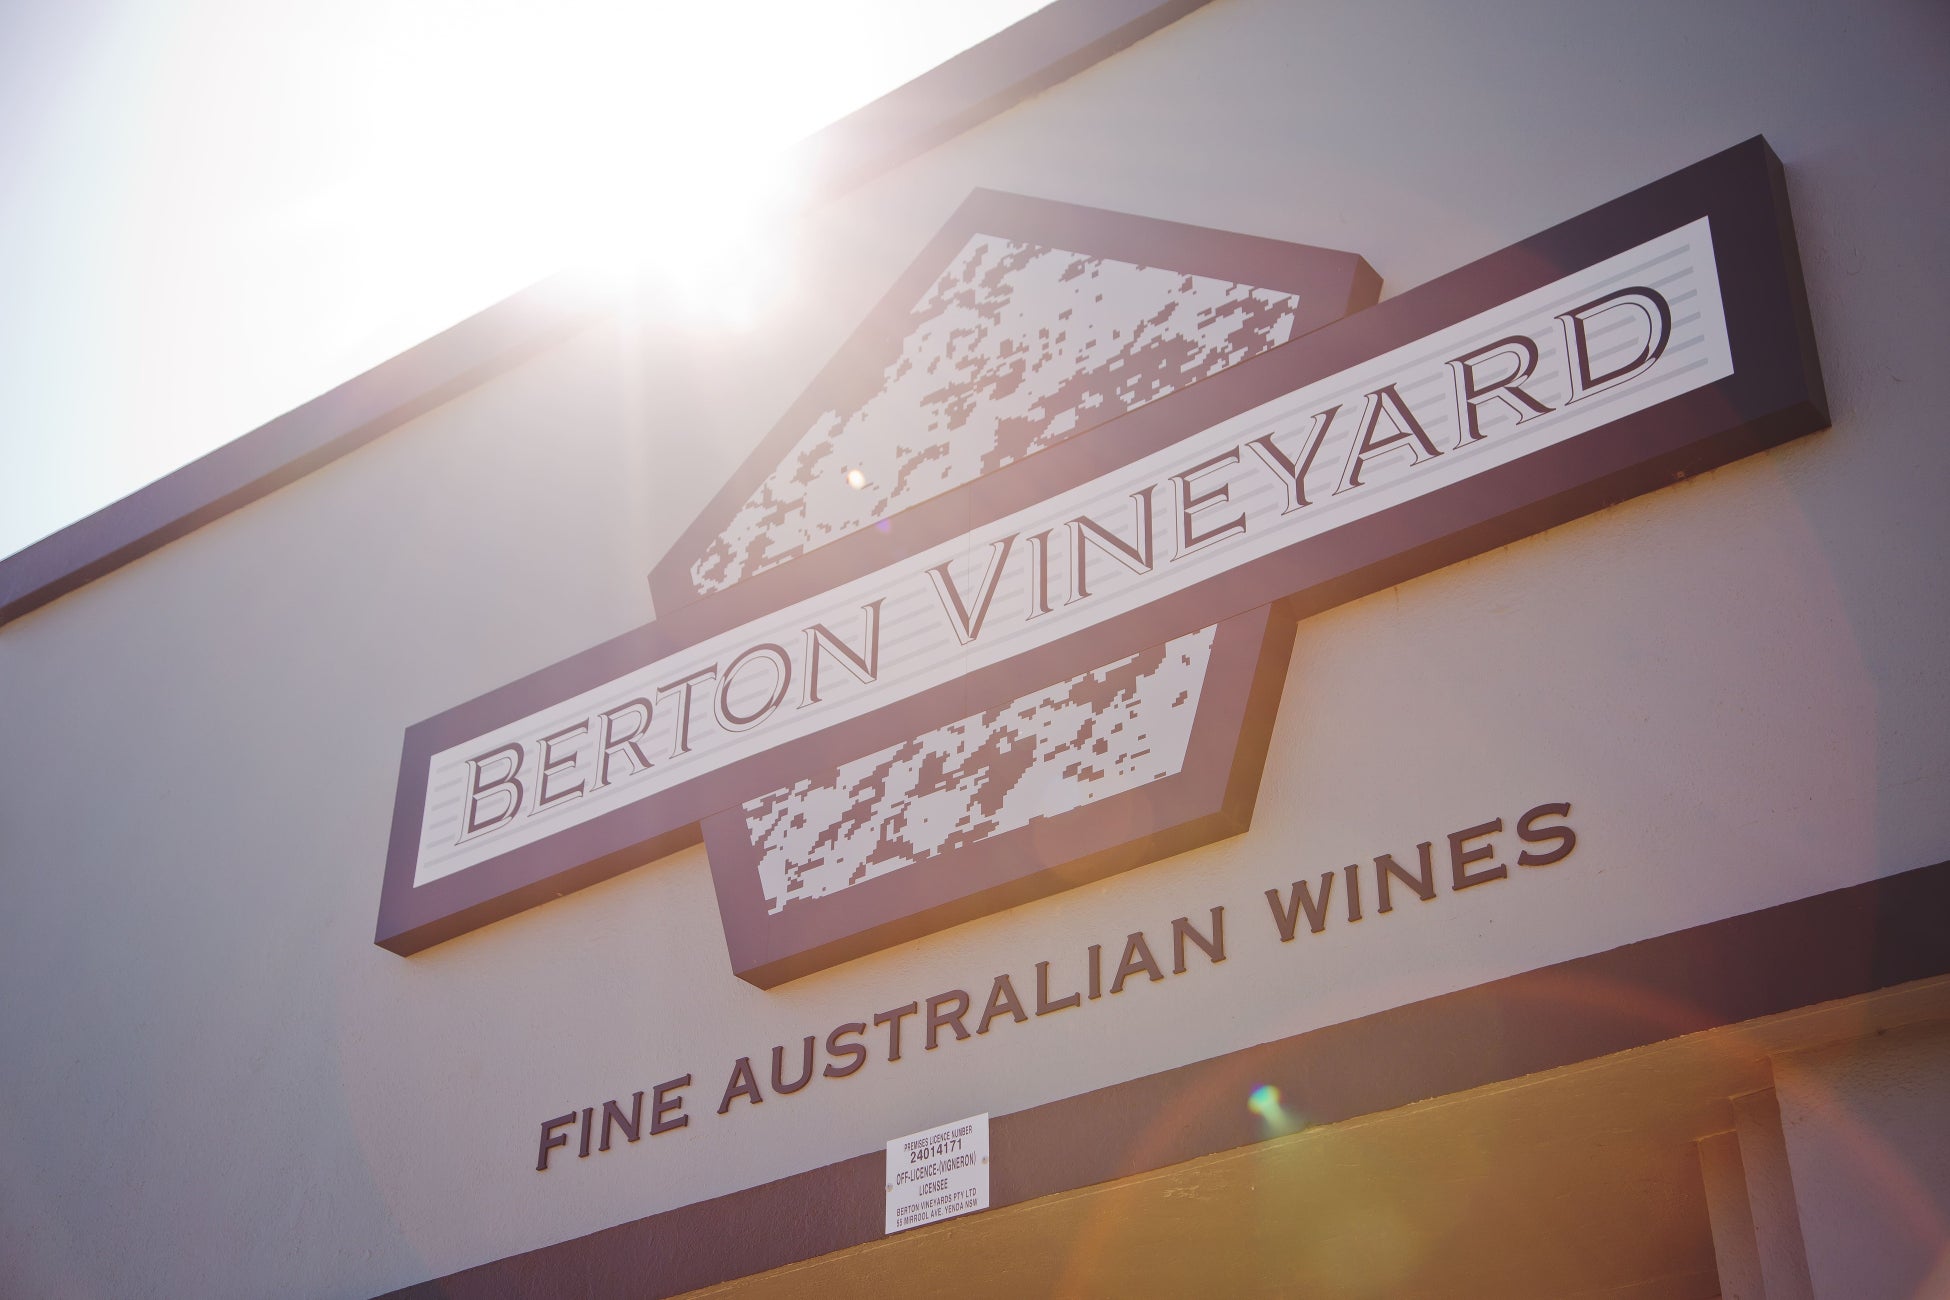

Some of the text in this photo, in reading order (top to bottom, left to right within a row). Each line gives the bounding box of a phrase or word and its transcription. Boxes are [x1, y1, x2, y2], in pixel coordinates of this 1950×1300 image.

[455, 286, 1672, 845] BERTON VINEYARD
[536, 802, 1578, 1171] FINE AUSTRALIAN WINES
[904, 1125, 973, 1152] PREMISES LICENCE NUMBER
[910, 1138, 962, 1163] 24014171
[919, 1178, 948, 1196] LICENSEE
[896, 1187, 977, 1217] BERTON VINEYARDS PTY LTD
[944, 1202, 963, 1215] YENDA
